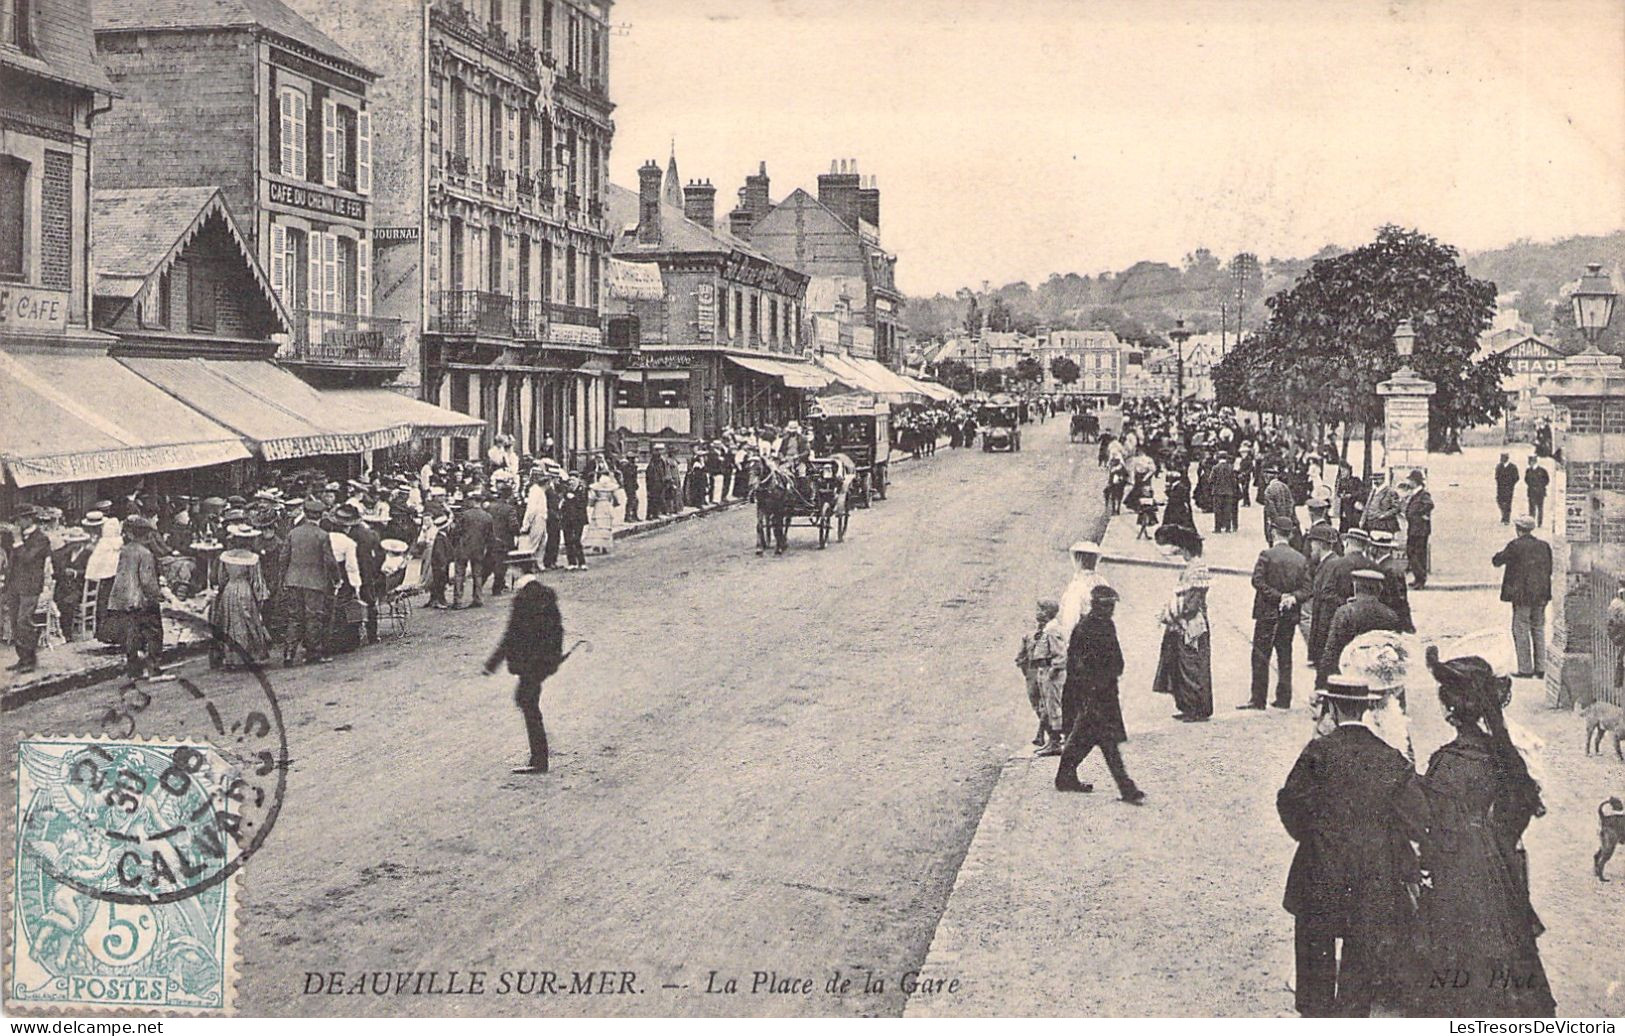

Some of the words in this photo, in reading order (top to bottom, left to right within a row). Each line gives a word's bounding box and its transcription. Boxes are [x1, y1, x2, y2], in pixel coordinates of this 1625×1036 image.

[271, 183, 293, 203] CAFE
[294, 189, 306, 206] DU
[307, 192, 334, 212] CHE
[347, 201, 362, 218] FER
[374, 228, 418, 239] JOURNAL
[17, 296, 60, 321] CAFE
[1510, 341, 1550, 357] GRAND
[1507, 359, 1567, 372] ARAGE
[72, 978, 163, 1000] POSTES
